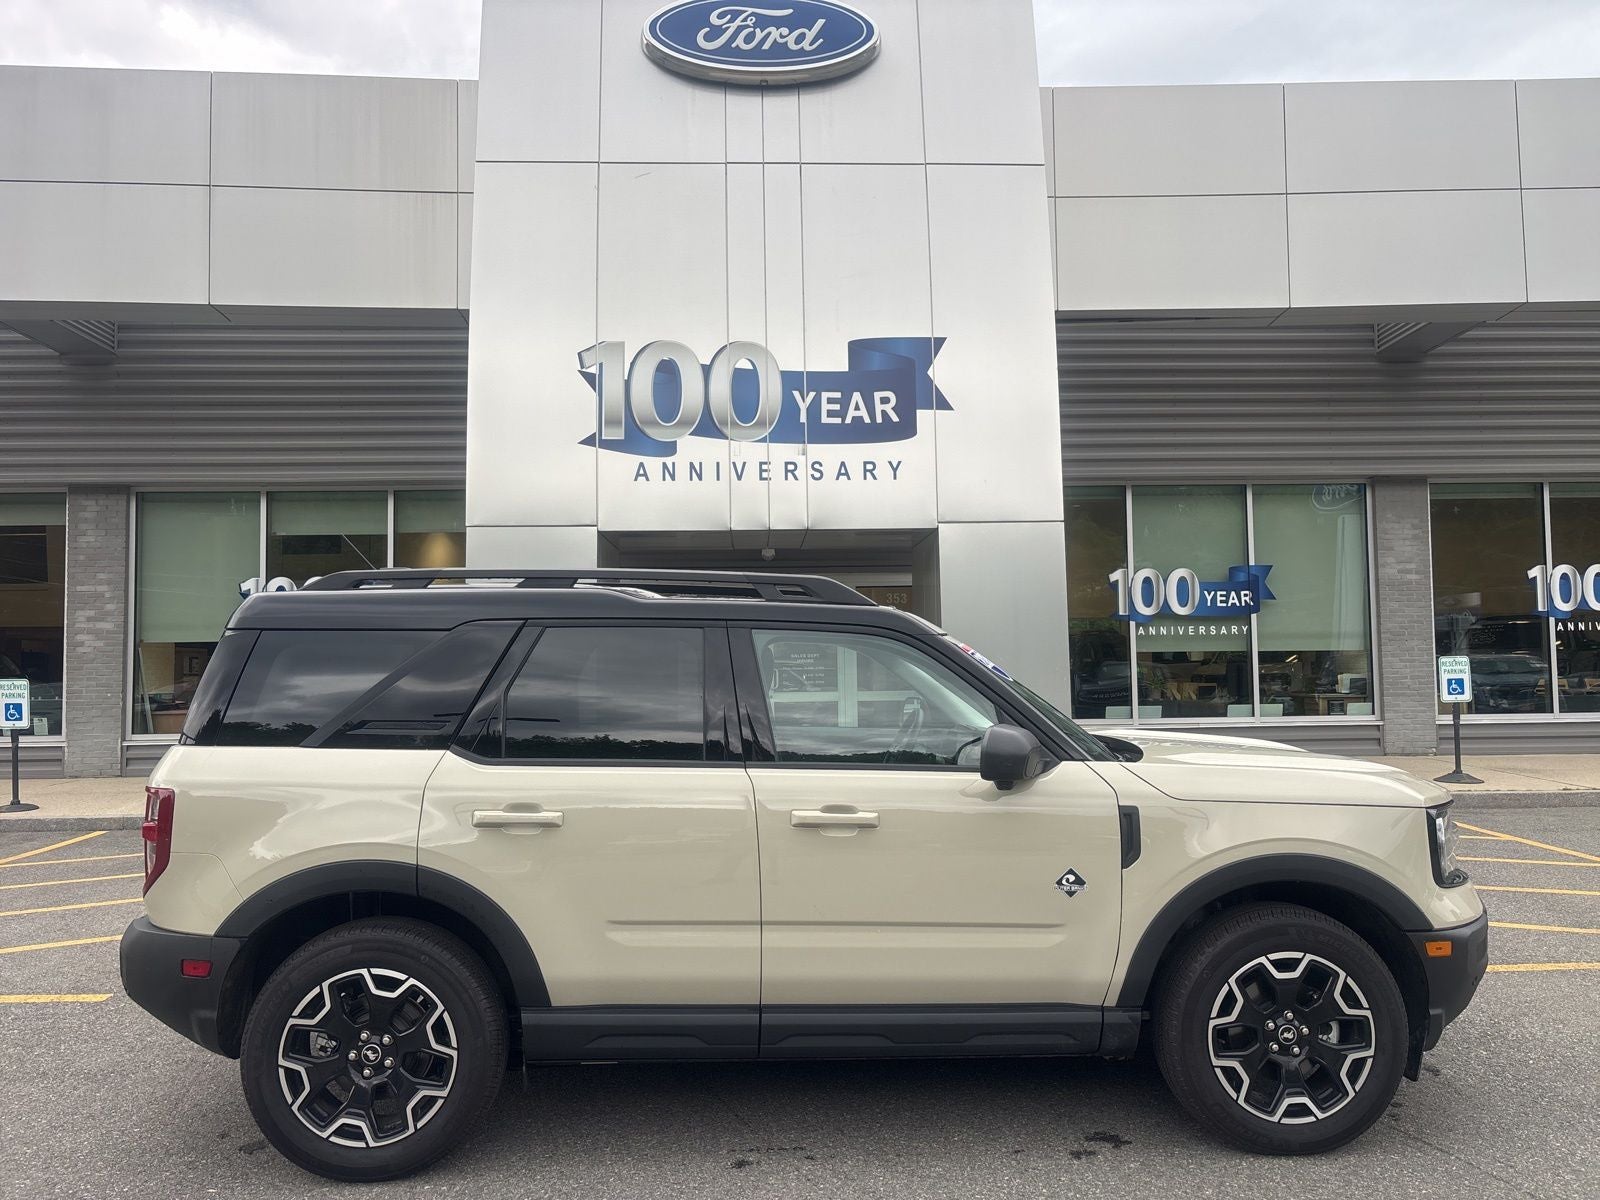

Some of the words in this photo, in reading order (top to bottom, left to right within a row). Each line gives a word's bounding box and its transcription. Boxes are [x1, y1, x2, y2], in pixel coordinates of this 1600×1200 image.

[696, 6, 824, 52] Ford
[577, 339, 783, 442] 100
[791, 390, 899, 424] YEAR
[633, 461, 903, 482] ANNIVERSARY
[886, 593, 907, 604] 353
[1108, 567, 1200, 616] 100
[1203, 590, 1253, 607] YEAR
[1137, 625, 1249, 636] ANNIVERSARY
